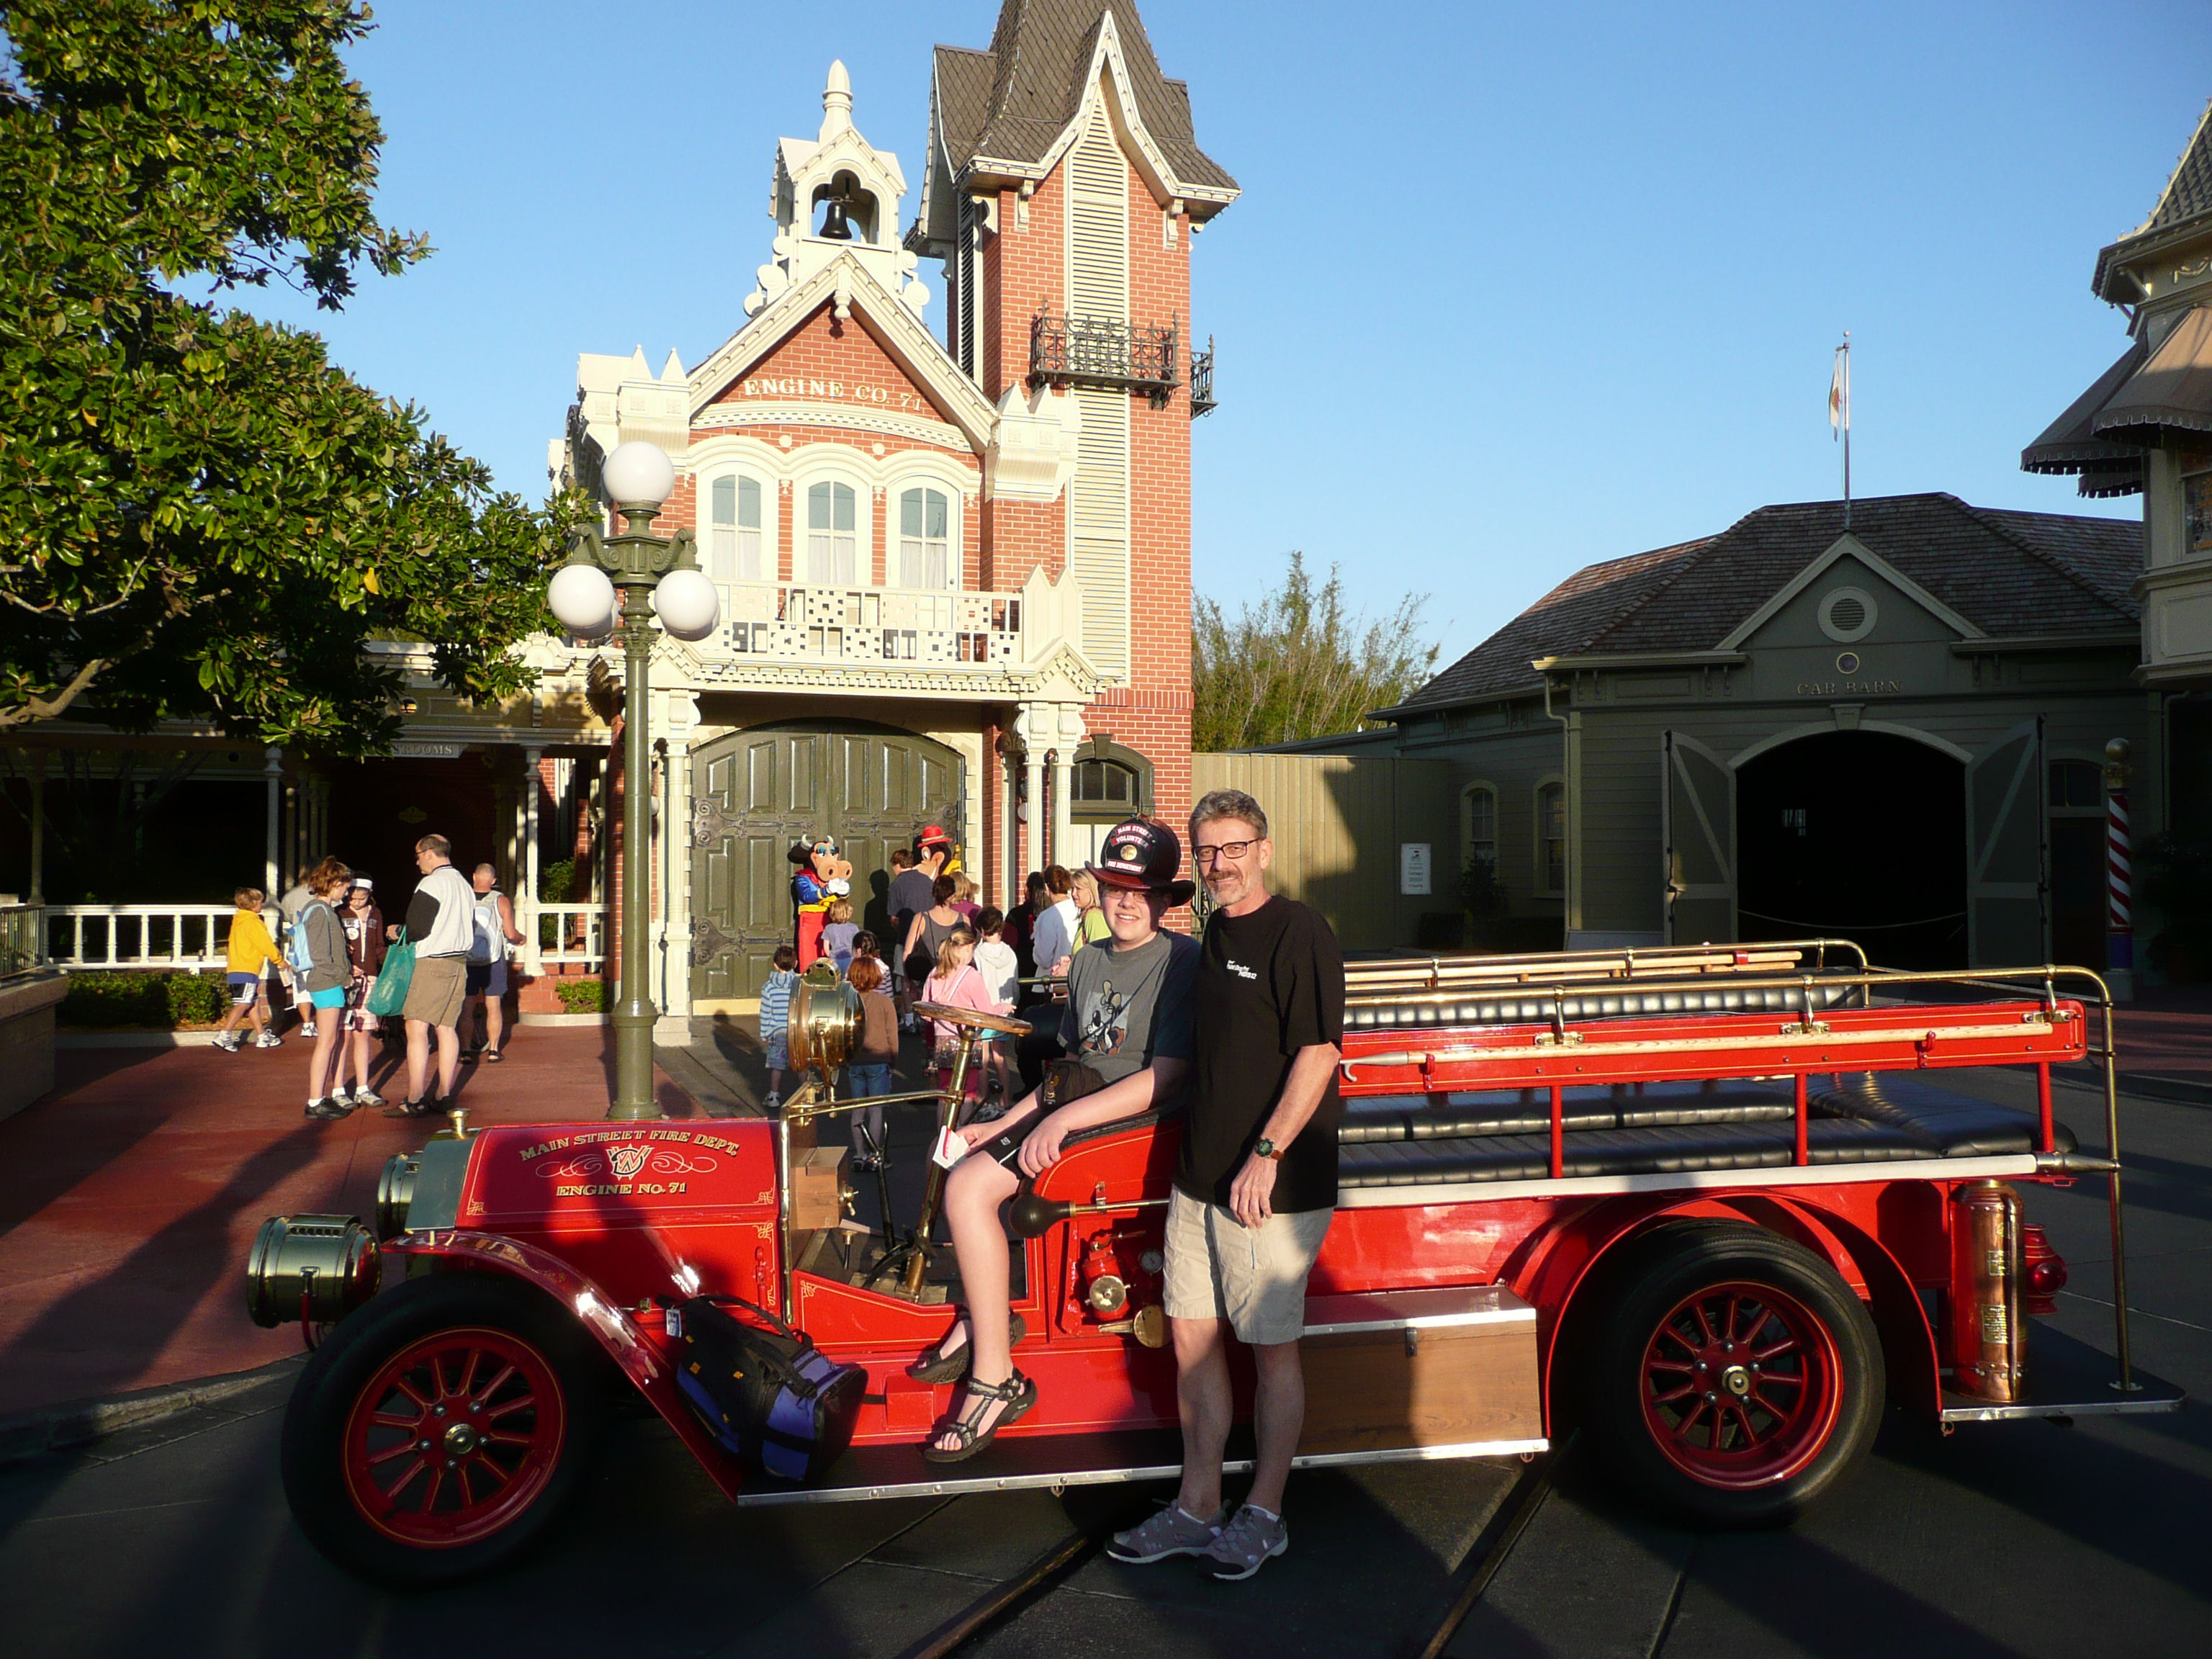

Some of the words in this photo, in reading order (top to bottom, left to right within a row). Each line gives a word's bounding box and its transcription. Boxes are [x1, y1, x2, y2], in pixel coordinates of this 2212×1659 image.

[743, 378, 843, 397] ENGINE
[855, 385, 890, 404] CO.
[900, 392, 921, 411] 71
[1797, 682, 1836, 696] CAR
[1844, 680, 1901, 696] BARN
[1118, 825, 1131, 835] MAIN
[1132, 825, 1152, 839] STREET
[1116, 835, 1149, 848] VOLUNTEER
[519, 1137, 570, 1161] MAIN
[574, 1130, 646, 1146] STREET
[649, 1130, 691, 1142] FIRE
[693, 1133, 740, 1156] DEPT.
[556, 1184, 633, 1197] ENGINE
[637, 1183, 667, 1195] NO.
[668, 1182, 688, 1194] 71
